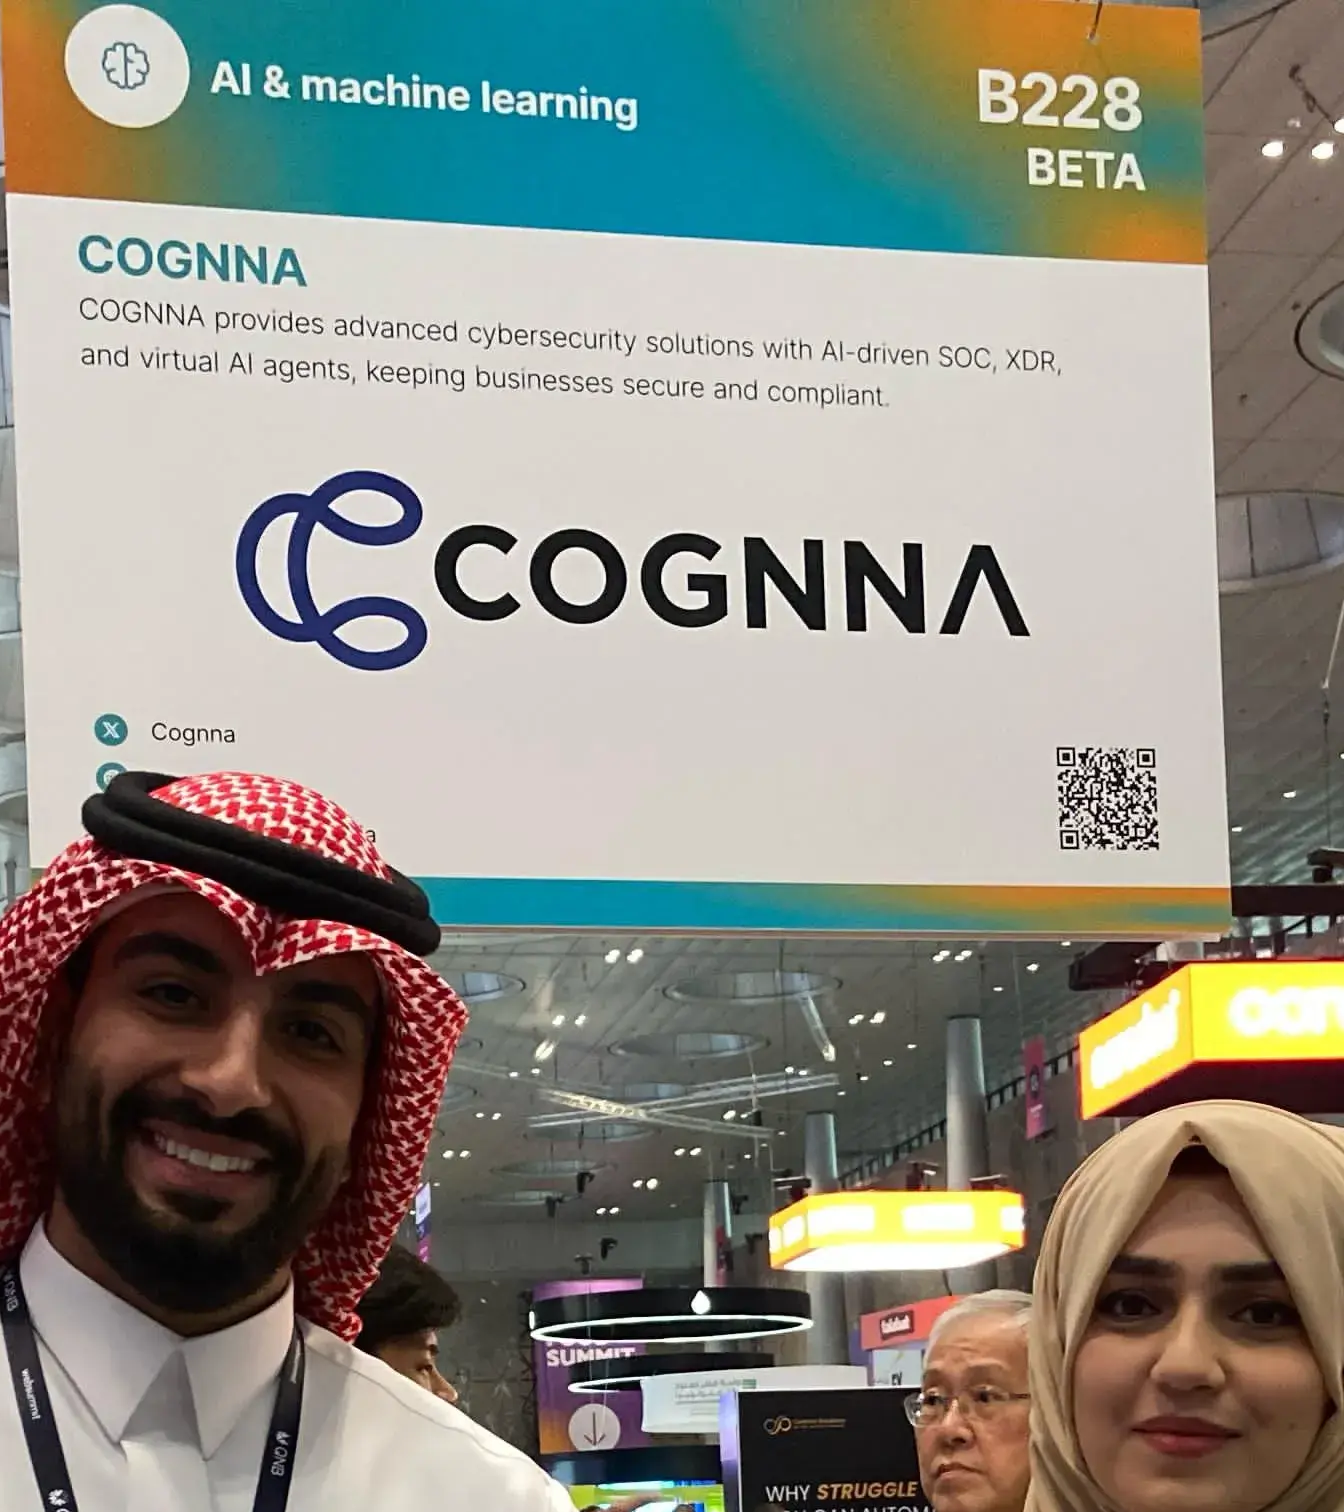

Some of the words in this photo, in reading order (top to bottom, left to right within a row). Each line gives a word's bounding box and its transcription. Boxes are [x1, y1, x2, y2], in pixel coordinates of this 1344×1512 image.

[211, 61, 251, 96] AI
[264, 66, 291, 99] &
[301, 70, 470, 112] machine
[481, 82, 638, 131] learning
[977, 68, 1143, 132] B228
[1027, 147, 1146, 191] BETA
[78, 235, 308, 287] COGNNA
[79, 298, 205, 329] COGNNA
[214, 308, 324, 335] provides
[333, 315, 458, 343] advanced
[467, 323, 636, 357] cybersecurity
[646, 332, 754, 358] solutions
[762, 338, 812, 361] with
[821, 341, 929, 367] AI-driven
[938, 346, 998, 373] SOC,
[1005, 350, 1063, 377] XDR,
[80, 344, 129, 369] and
[140, 347, 219, 374] virtual
[229, 352, 253, 376] AI
[262, 356, 357, 385] agents,
[366, 362, 465, 391] keeping
[475, 367, 614, 395] businesses
[622, 376, 705, 400] secure
[713, 378, 759, 403] and
[767, 381, 890, 408] compliant.
[151, 722, 236, 746] Cognna
[270, 1446, 289, 1477] QNB
[765, 1484, 810, 1502] WHY
[816, 1481, 919, 1500] STRUGGLE
